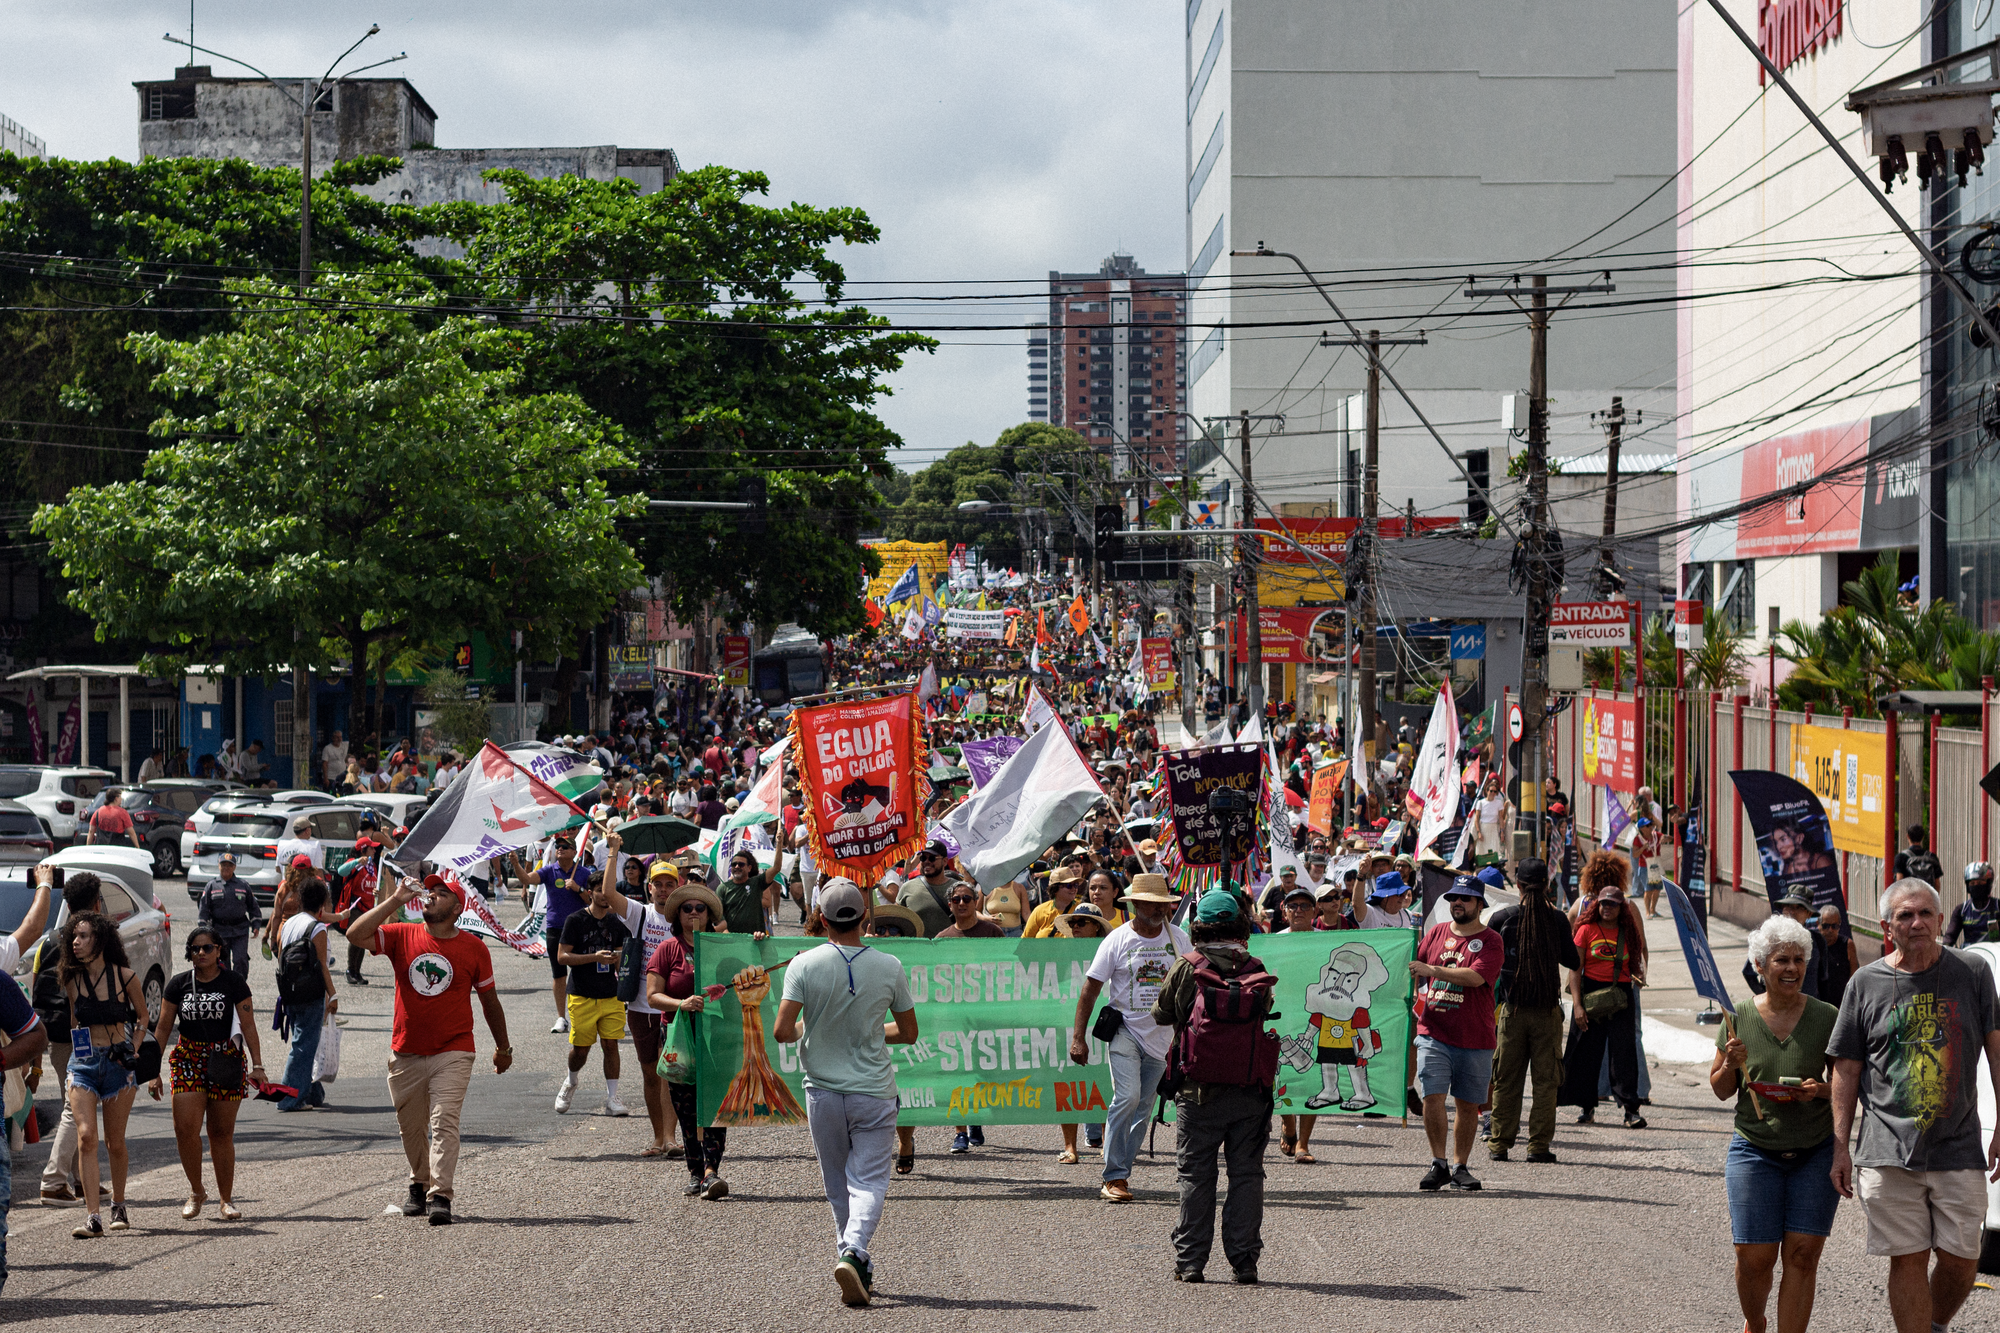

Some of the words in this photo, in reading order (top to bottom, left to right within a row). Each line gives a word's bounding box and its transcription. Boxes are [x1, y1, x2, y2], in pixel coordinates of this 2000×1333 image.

[1269, 544, 1347, 552] ELEROLED
[1552, 605, 1625, 622] ENTRADA
[1568, 625, 1625, 640] VEÍCULOS
[815, 719, 893, 764] ÉGUA
[821, 764, 844, 785] DO
[848, 749, 896, 778] CALOR
[1168, 763, 1202, 783] Toda
[1194, 771, 1255, 795] REVOLUÇÃO
[1173, 803, 1208, 817] Parece
[825, 830, 855, 846] MUDAR
[857, 827, 866, 839] O
[868, 813, 904, 837] SISTEMA
[1184, 815, 1205, 830] até
[841, 842, 861, 858] NÃO
[863, 843, 871, 854] O
[874, 832, 896, 854] CLIMA
[933, 960, 1069, 1005] SISTEMA,
[1912, 992, 1934, 1004] BOB
[899, 1036, 938, 1068] THE
[937, 1027, 1066, 1074] SYSTEM,
[1053, 1080, 1109, 1113] RUA
